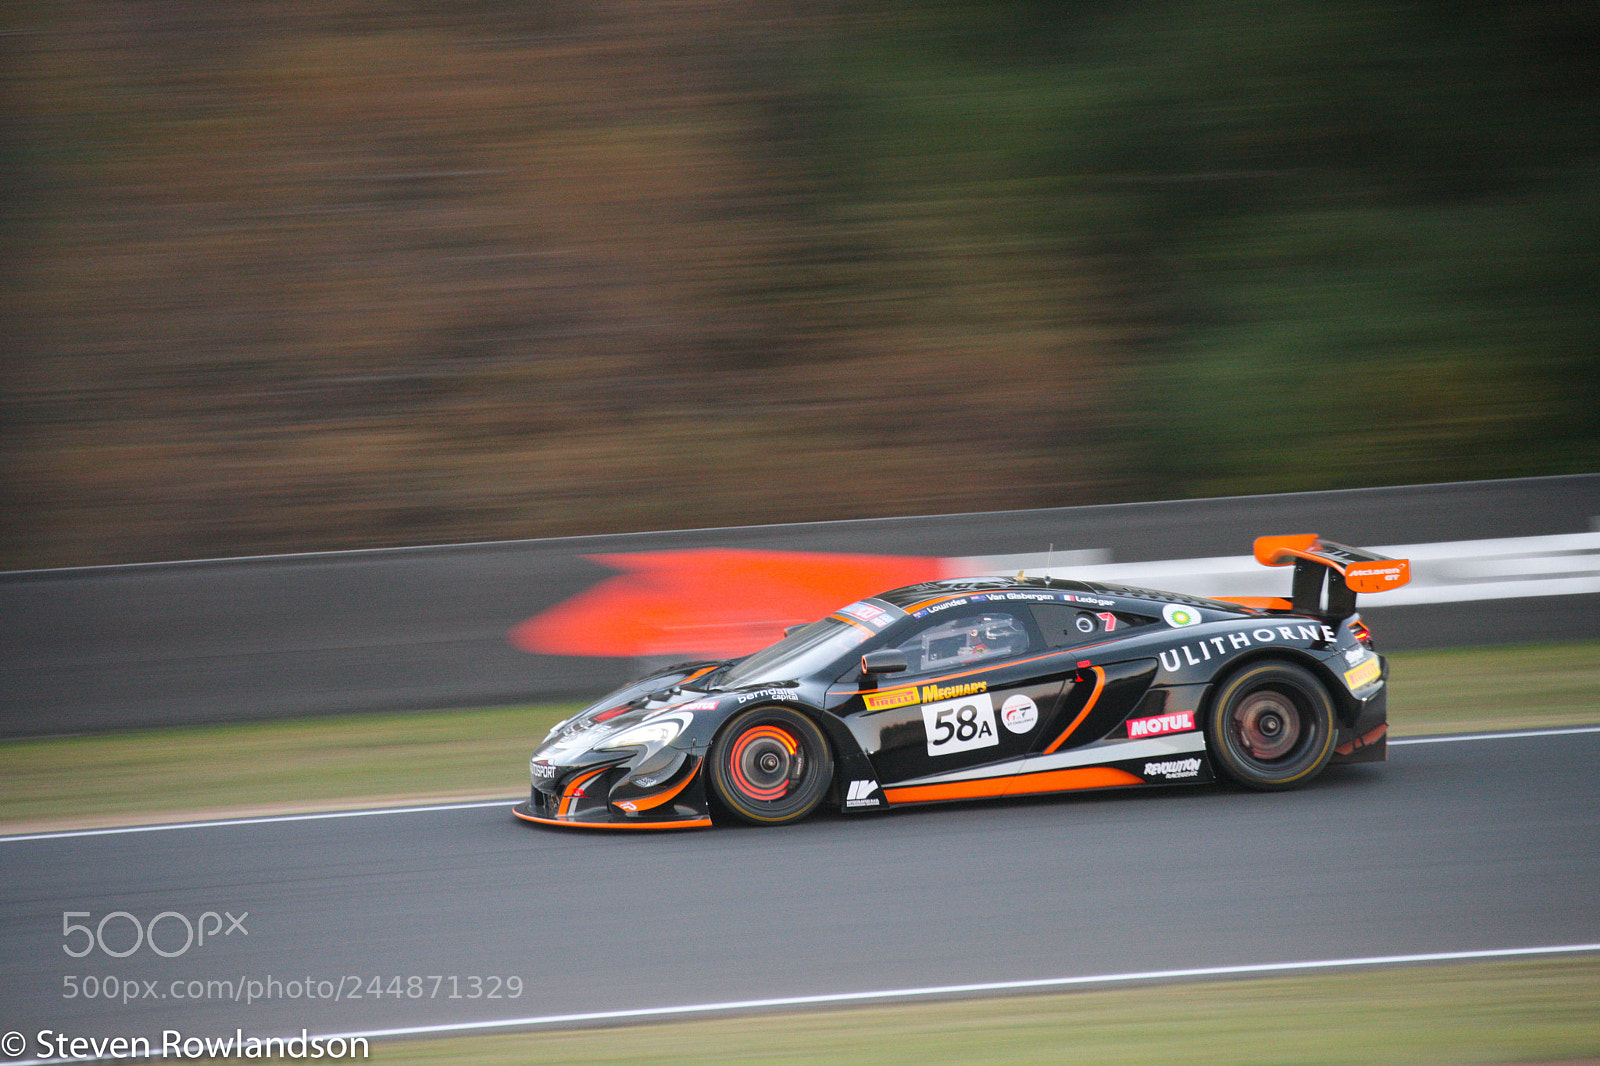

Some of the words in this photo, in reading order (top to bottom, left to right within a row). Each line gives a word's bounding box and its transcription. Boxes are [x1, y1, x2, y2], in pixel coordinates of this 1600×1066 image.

[1349, 567, 1400, 577] McLaren
[986, 593, 1006, 602] Van
[1075, 596, 1116, 608] Ledogar
[927, 598, 968, 614] Lowndes
[1159, 624, 1338, 673] ULITHORNE
[737, 687, 796, 704] berndale
[771, 693, 799, 702] capital
[868, 690, 915, 708] PIRELLI
[1131, 714, 1192, 736] MOTUL
[1143, 758, 1202, 776] REVOLUTION
